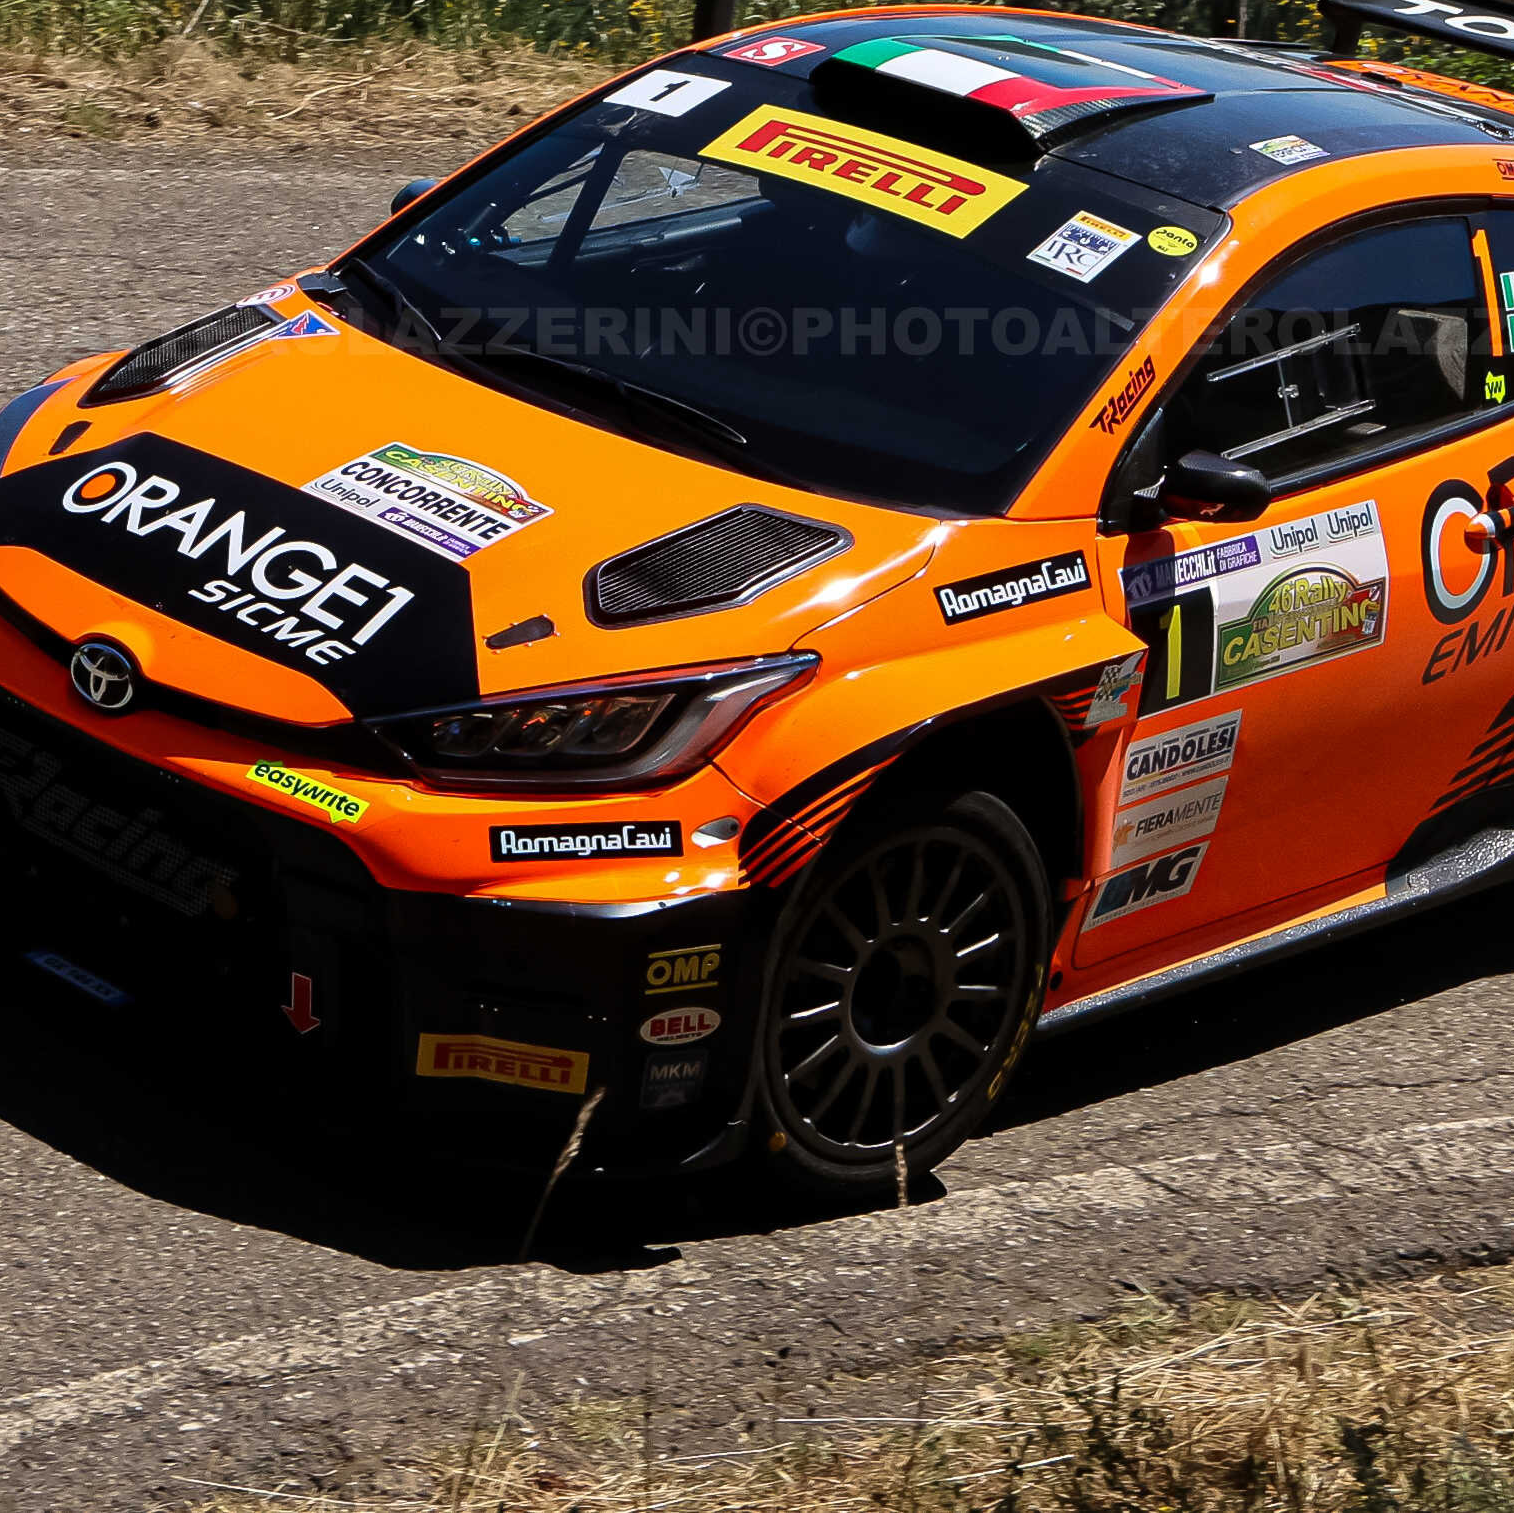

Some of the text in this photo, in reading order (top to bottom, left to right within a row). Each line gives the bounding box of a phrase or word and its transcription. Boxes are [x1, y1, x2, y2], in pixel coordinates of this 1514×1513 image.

[650, 80, 692, 102] 1
[736, 120, 986, 215] PIRELLI
[321, 478, 382, 509] Unipol
[340, 461, 513, 541] CONCORRENTE
[1216, 541, 1247, 560] FABBRICA
[1271, 502, 1374, 553] Unipol Unipol
[62, 461, 416, 647] ORANGE1
[1227, 550, 1258, 570] GRAFICHE
[939, 558, 1087, 618] RomagnaCavi
[1295, 575, 1348, 610] Rally
[187, 579, 357, 666] SICME
[1161, 604, 1182, 700] 1
[1127, 725, 1237, 781] CANDOLESI
[254, 763, 360, 817] easywrite
[1135, 791, 1223, 838] FIERAMENTE
[500, 824, 672, 856] RomagnaCavi
[646, 952, 721, 986] OMP
[650, 1013, 713, 1038] BELL
[433, 1042, 575, 1085] PIRELLI
